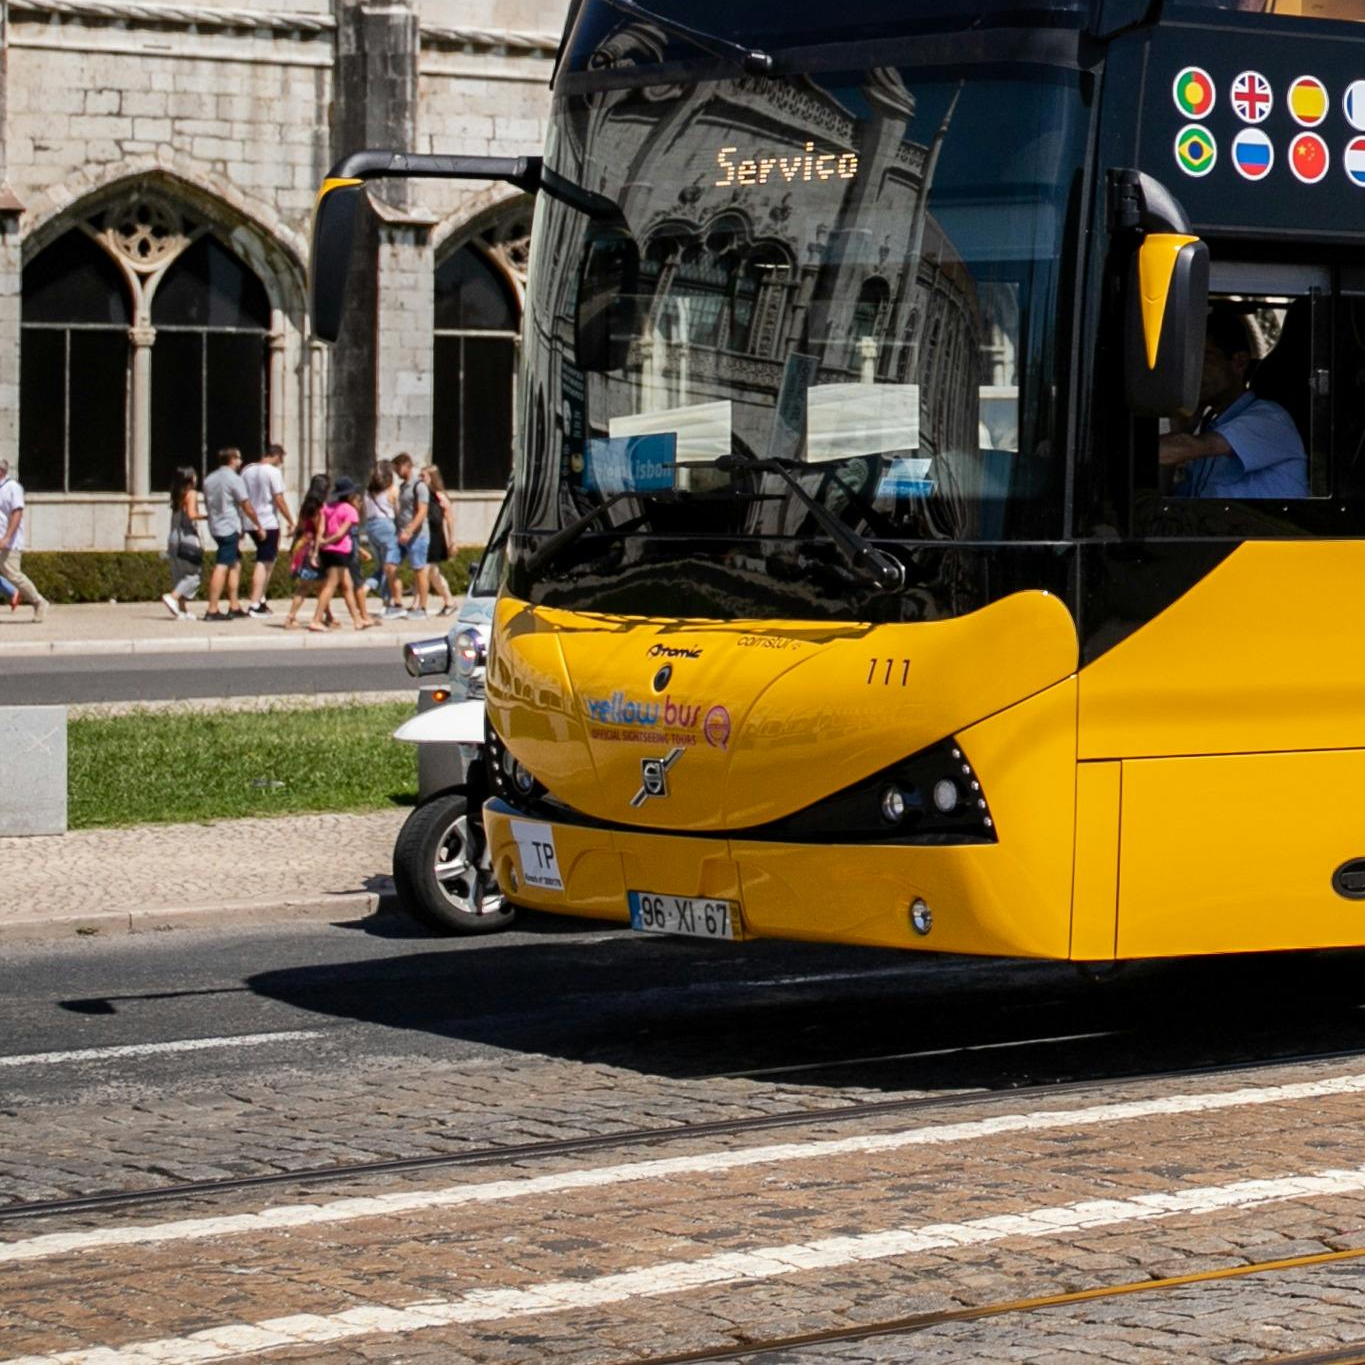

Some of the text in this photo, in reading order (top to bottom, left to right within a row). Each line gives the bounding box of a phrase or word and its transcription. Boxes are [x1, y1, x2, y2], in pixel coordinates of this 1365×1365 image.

[867, 658, 911, 686] 111
[664, 695, 701, 727] bus
[531, 841, 554, 870] TP
